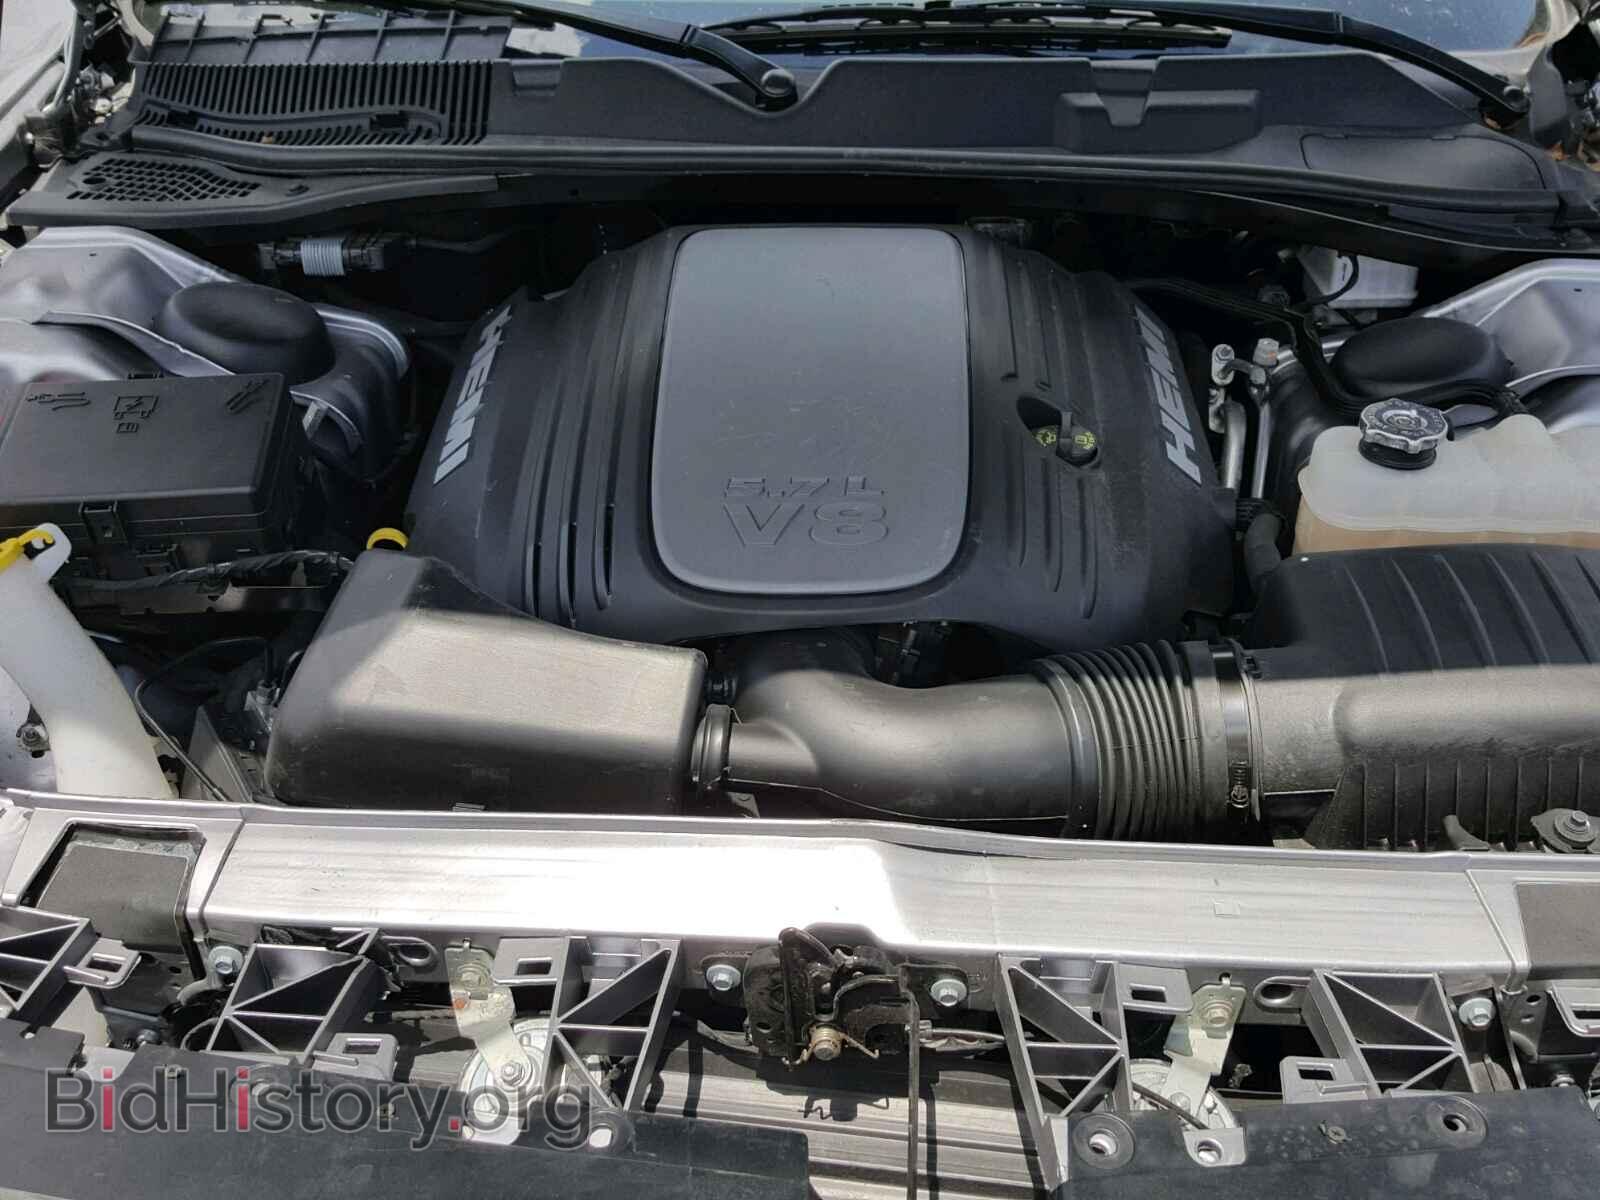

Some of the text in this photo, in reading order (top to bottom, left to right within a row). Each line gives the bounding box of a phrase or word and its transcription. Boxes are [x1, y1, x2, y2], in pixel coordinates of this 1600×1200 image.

[433, 304, 512, 485] HEMI
[1134, 304, 1202, 485] HEMI
[723, 503, 888, 545] V8
